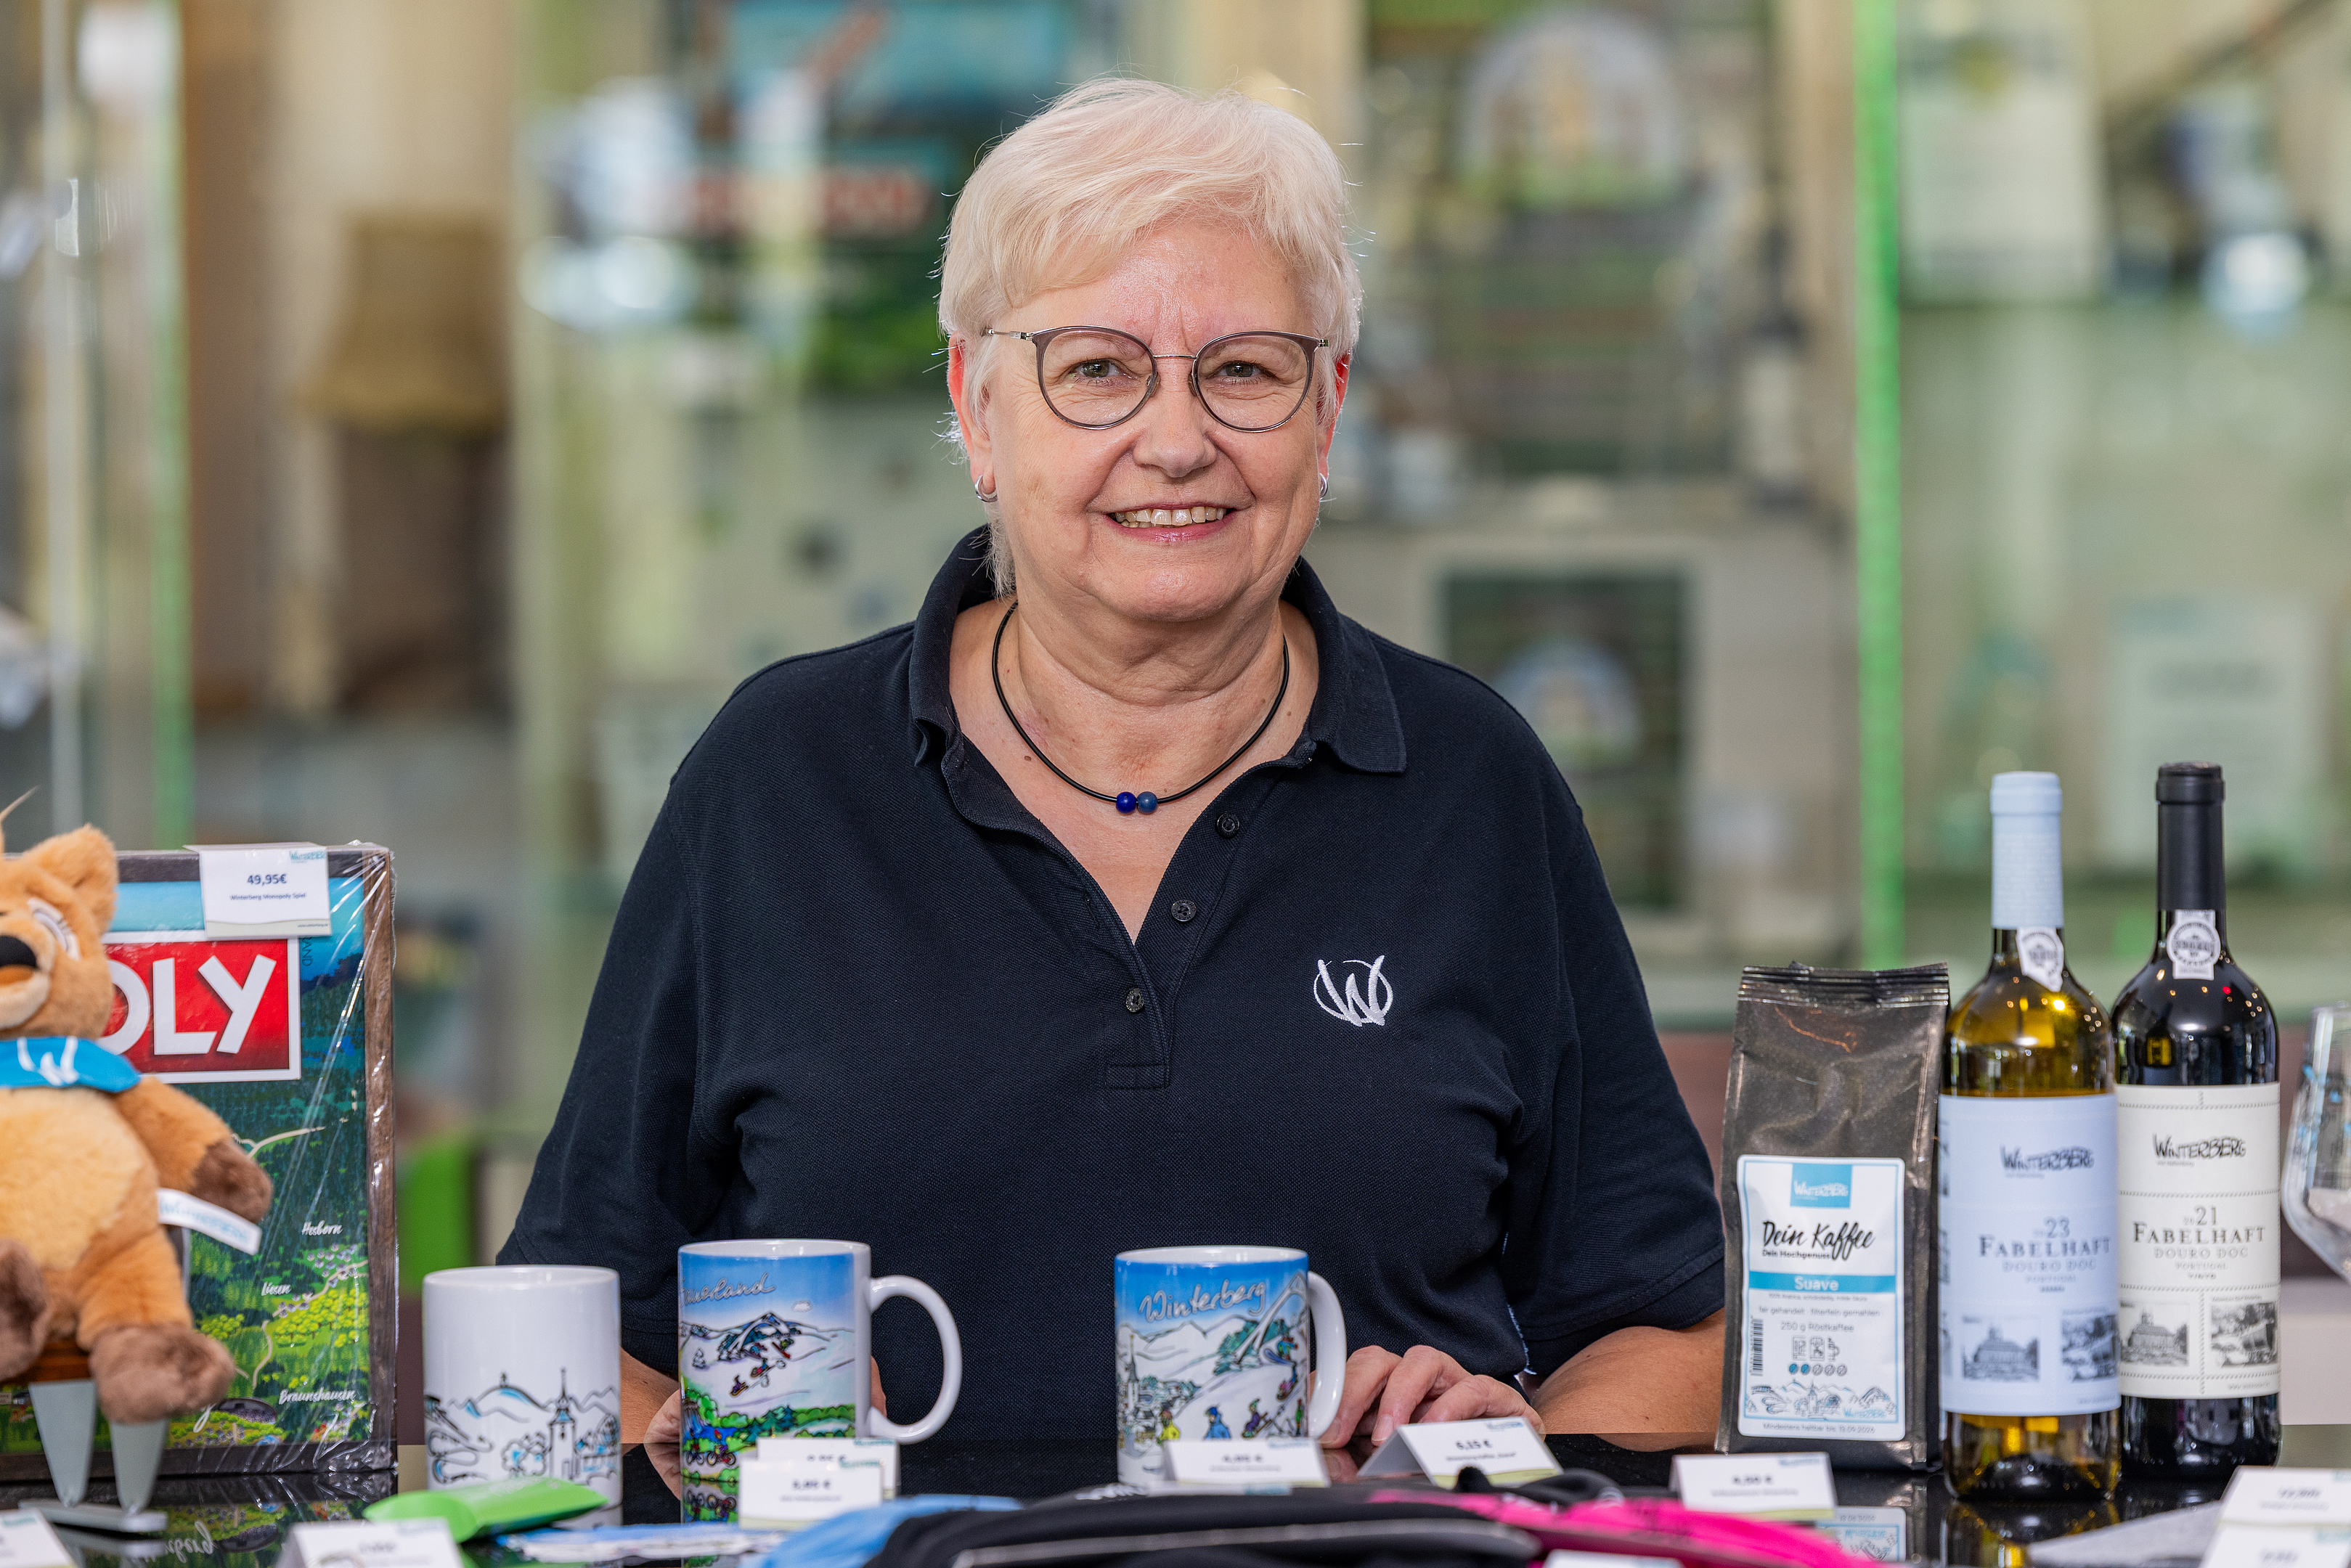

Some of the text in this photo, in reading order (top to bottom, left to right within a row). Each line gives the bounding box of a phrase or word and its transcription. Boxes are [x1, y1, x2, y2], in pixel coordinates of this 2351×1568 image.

[247, 873, 287, 886] 49,95€
[301, 1220, 343, 1236] Hesborn
[2132, 1222, 2266, 1244] FABELHAFT
[1763, 1221, 1875, 1260] Dein Kaffee
[1979, 1234, 2111, 1258] FABELHAFT
[1780, 1251, 1830, 1260] Hochgenuss
[2154, 1246, 2249, 1259] DOURO DOC
[2002, 1258, 2062, 1273] DOURO
[261, 1282, 292, 1296] Liesen
[1794, 1275, 1839, 1291] Suave
[1138, 1278, 1266, 1323] Winterberg
[1771, 1307, 1806, 1315] gehandelt
[1843, 1309, 1881, 1318] gemahlen
[1781, 1321, 1854, 1333] 250 g Röstkaffee
[279, 1387, 356, 1405] Braunshausen
